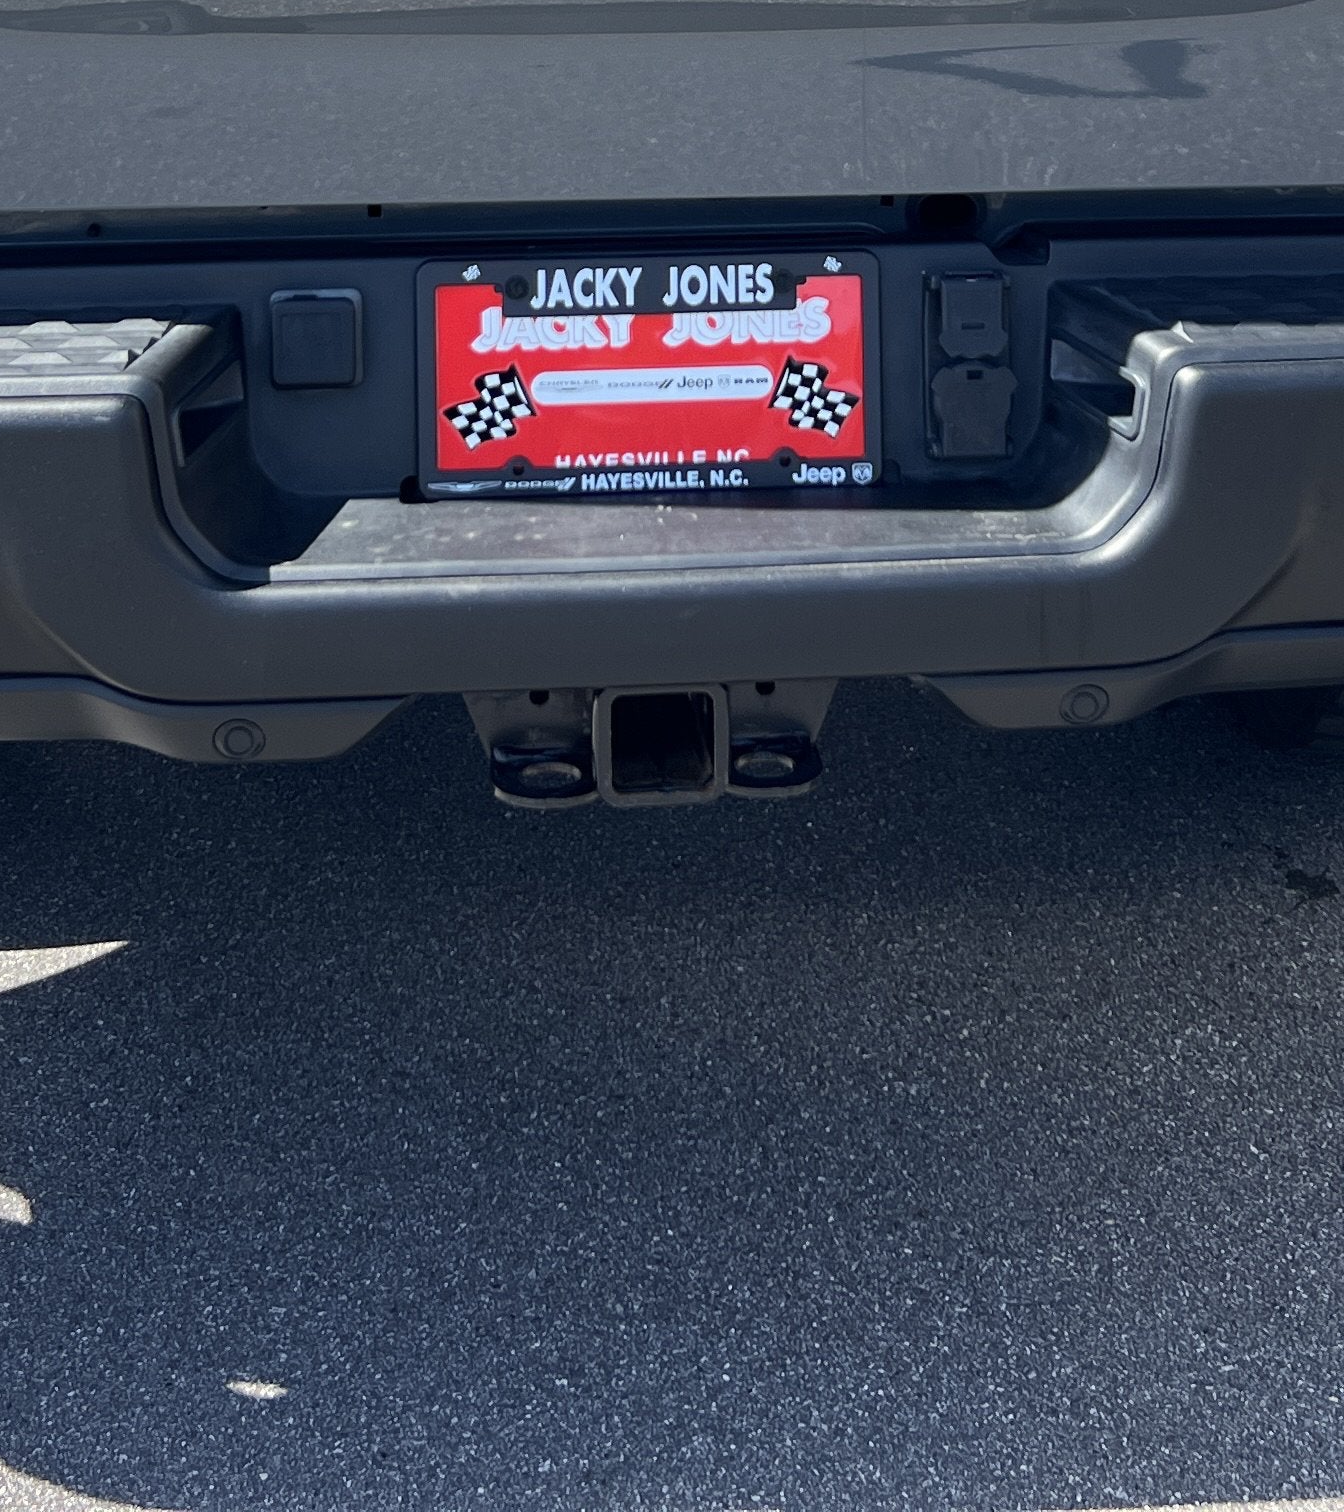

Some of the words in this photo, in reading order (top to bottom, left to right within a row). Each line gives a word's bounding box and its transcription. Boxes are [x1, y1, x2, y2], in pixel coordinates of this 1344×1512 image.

[530, 265, 643, 310] JACKY
[662, 262, 775, 307] JONES
[470, 304, 636, 353] JACKY
[662, 296, 833, 347] JONES
[677, 375, 714, 390] Jeep
[581, 470, 705, 491] HAYESVILLE,
[710, 468, 749, 487] N.C.
[792, 463, 846, 486] Jeep
